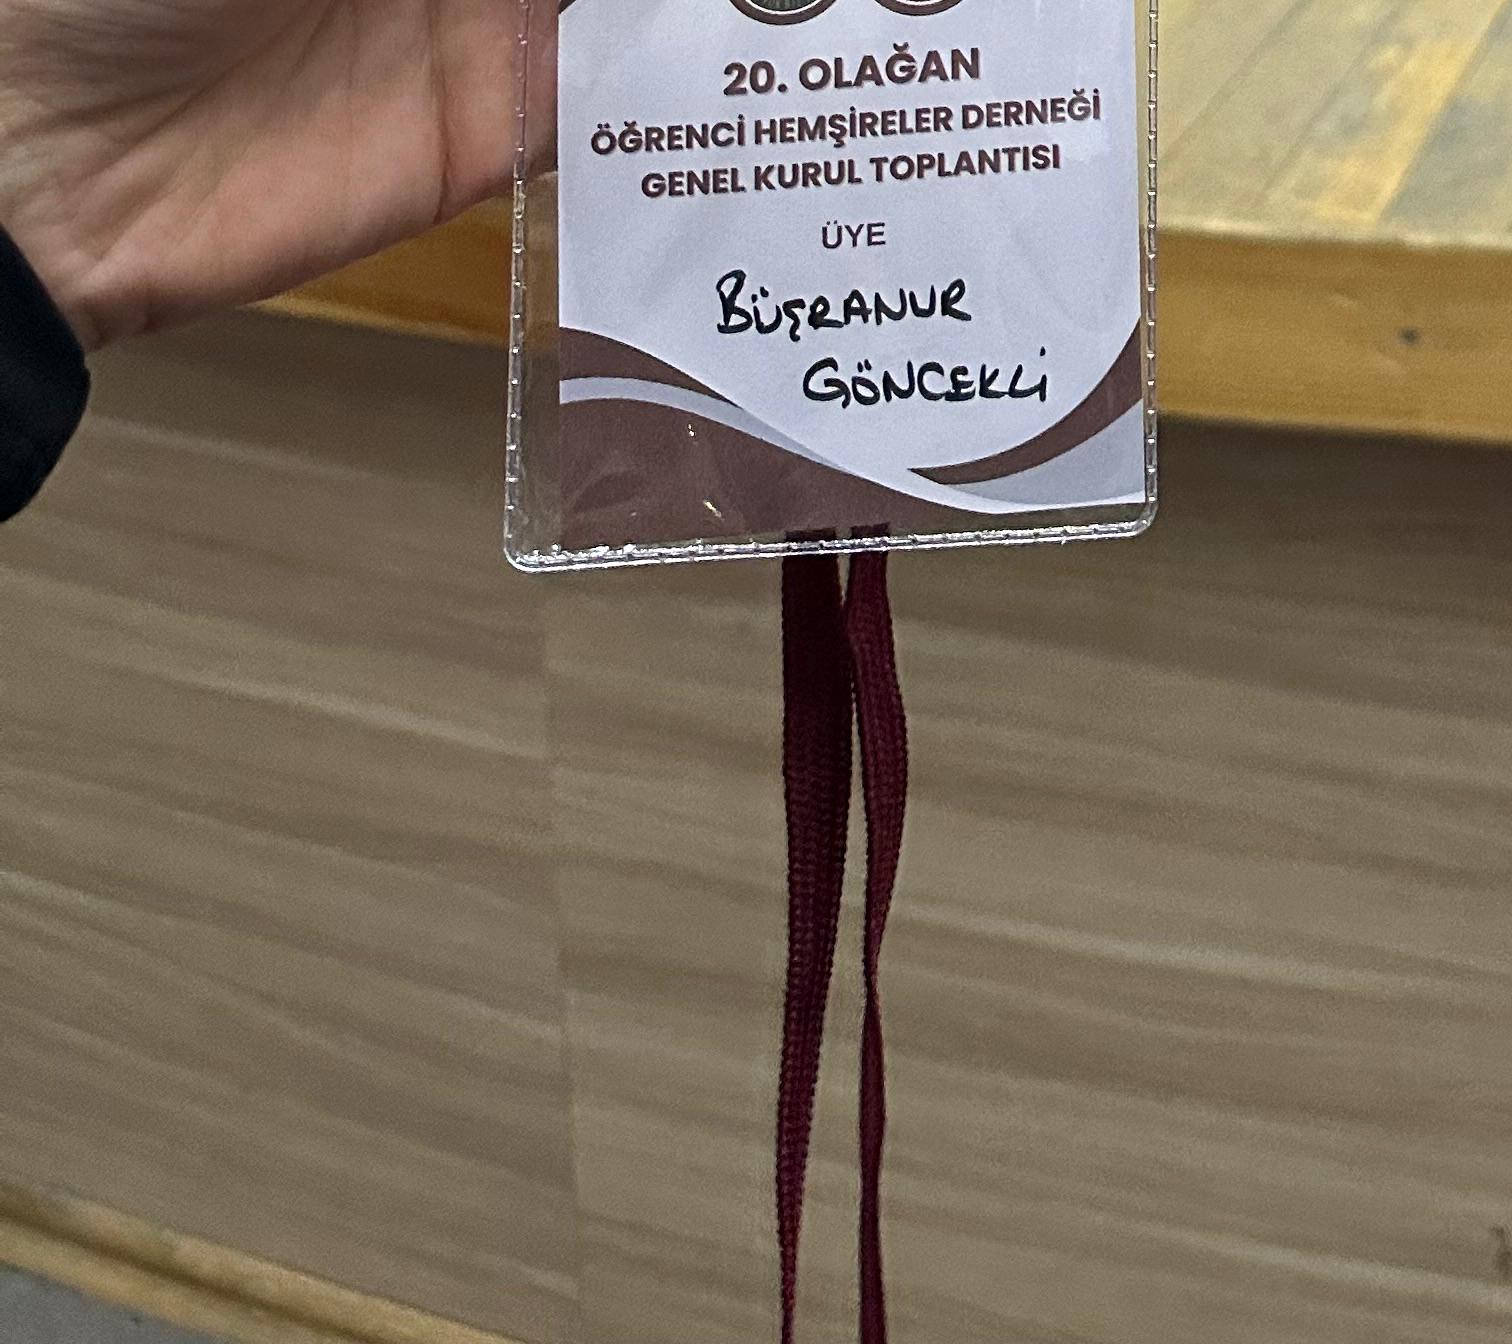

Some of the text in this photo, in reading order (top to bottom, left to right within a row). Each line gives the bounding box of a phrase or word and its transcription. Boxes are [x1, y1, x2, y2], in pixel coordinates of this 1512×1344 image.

[723, 41, 981, 96] 20. OLAĞAN
[590, 87, 1102, 155] ÖĞRENCİ HEMŞİRELER DERNEĞİ
[641, 143, 1061, 198] GENEL KURUL TOPLANTISI
[821, 220, 886, 250] ÜYE
